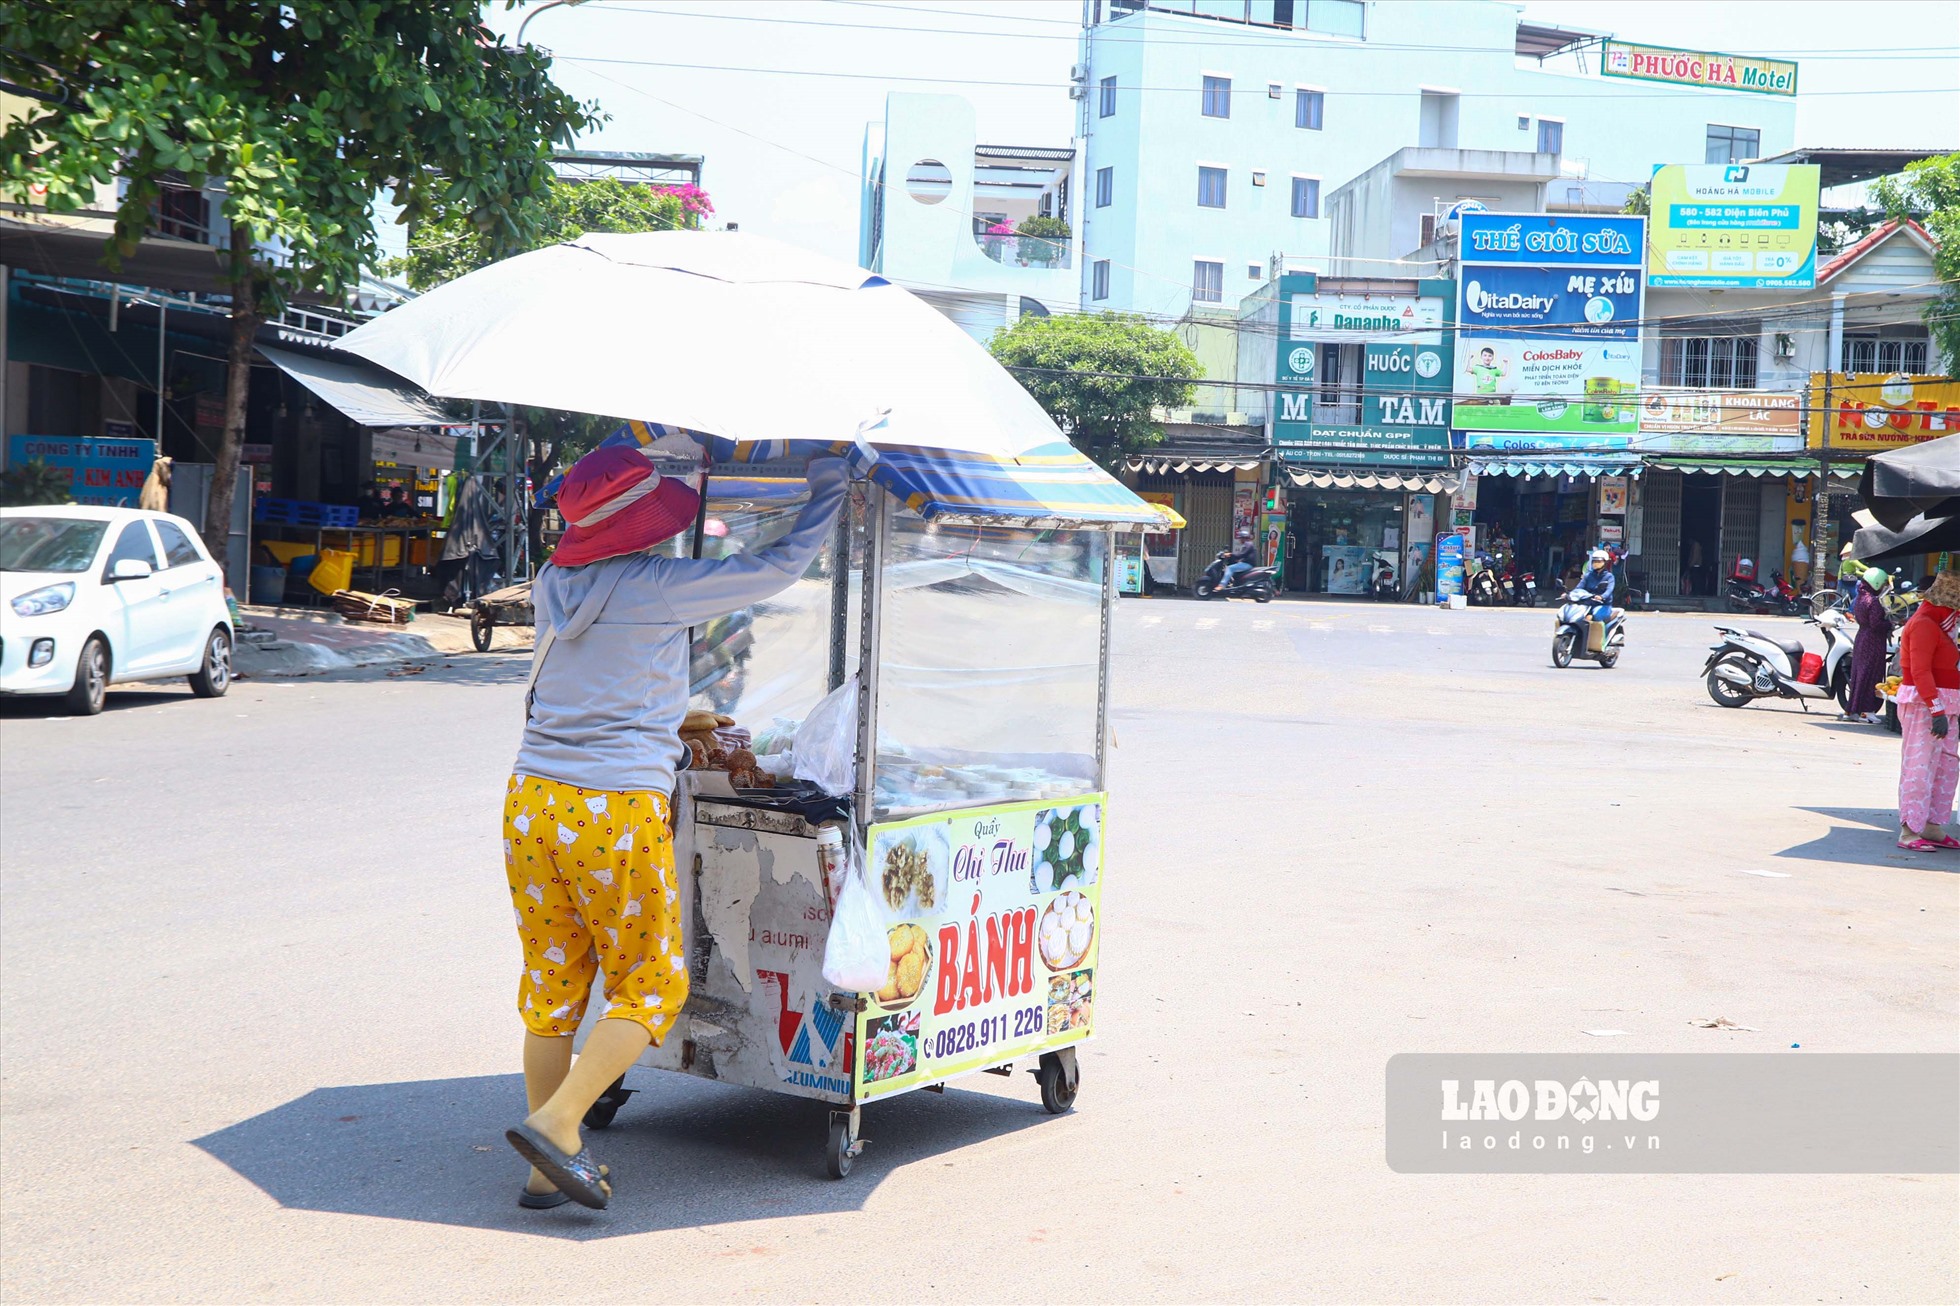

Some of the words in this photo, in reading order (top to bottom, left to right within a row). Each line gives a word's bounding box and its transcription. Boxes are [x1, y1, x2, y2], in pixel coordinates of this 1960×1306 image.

[1632, 53, 1703, 79] PHƯỚC
[1707, 58, 1737, 84] HÀ
[1742, 66, 1793, 90] Motel
[1696, 187, 1725, 196] HOÀNG
[1727, 187, 1739, 195] HÀ
[1742, 188, 1775, 196] MOBILE
[1680, 208, 1698, 217] 580
[1705, 208, 1722, 217] 582
[1724, 208, 1745, 219] Điện
[1748, 208, 1770, 217] Biên
[1771, 207, 1790, 217] Phủ
[1472, 223, 1522, 252] THẾ
[1525, 227, 1578, 252] GIỚI
[1582, 228, 1632, 254] SỮA
[1567, 275, 1596, 298] MẸ
[1599, 271, 1635, 294] XÍU
[1466, 280, 1554, 314] VitaDairy
[1334, 313, 1401, 332] Danapha
[1615, 328, 1626, 336] mẹ
[1368, 347, 1411, 373] HUỐC
[1522, 348, 1584, 362] ColosBaby
[1541, 365, 1562, 373] DỊCH
[1280, 393, 1309, 421] M
[1378, 393, 1447, 426] TÂM
[1725, 397, 1763, 407] KHOAI
[1764, 398, 1796, 408] LANG
[1312, 429, 1337, 438] ĐẠT
[1338, 428, 1382, 439] CHUẨN
[1385, 432, 1411, 440] GPP
[1840, 431, 1858, 441] TRÀ
[1858, 430, 1876, 441] SỮA
[1877, 431, 1909, 442] NƯỚNG
[24, 441, 69, 456] CÔNG
[75, 443, 92, 456] TY
[97, 444, 139, 458] TNHH
[84, 468, 111, 487] KIM
[114, 469, 145, 488] ANH
[974, 817, 1001, 840] Quầy
[953, 844, 985, 886] Chị
[991, 839, 1029, 876] Thu
[933, 889, 1038, 1017] BÁNH
[935, 1012, 1007, 1059] 0828.911
[1013, 1004, 1043, 1038] 226
